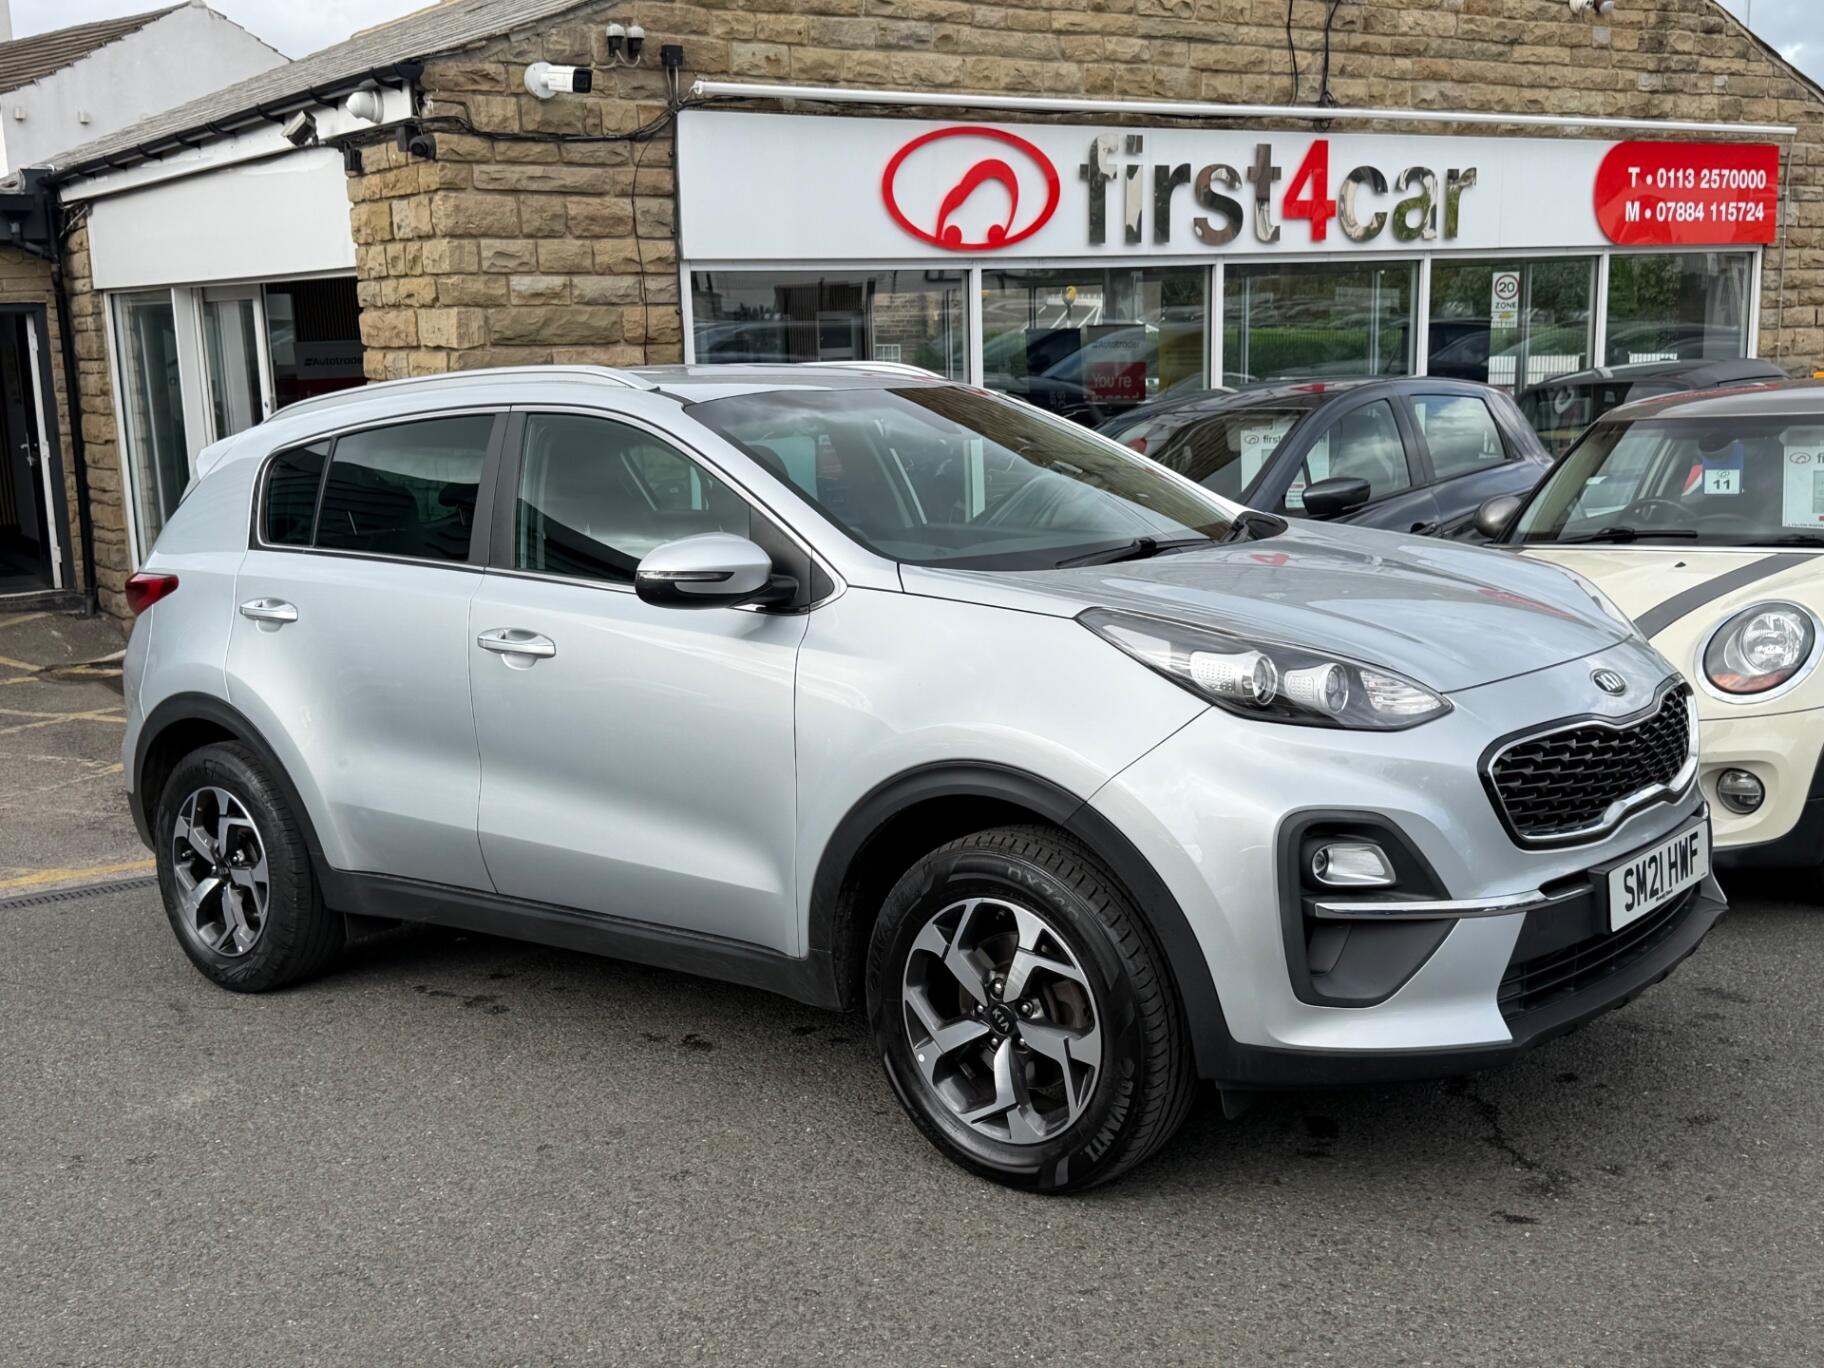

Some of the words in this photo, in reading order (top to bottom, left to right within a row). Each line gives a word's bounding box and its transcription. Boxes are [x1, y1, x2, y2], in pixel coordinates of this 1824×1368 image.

[1628, 166, 1640, 188] T
[1657, 167, 1695, 189] 0113
[1700, 168, 1767, 189] 2570000
[1079, 132, 1477, 246] first4car
[1625, 201, 1640, 222] M
[1656, 201, 1704, 222] 07884
[1710, 202, 1765, 222] 115724
[1498, 281, 1516, 293] 20
[1495, 301, 1517, 309] ZONE
[1091, 372, 1133, 388] You're
[1713, 479, 1731, 490] 11
[1623, 850, 1664, 912] SM21
[1667, 831, 1698, 888] HWF
